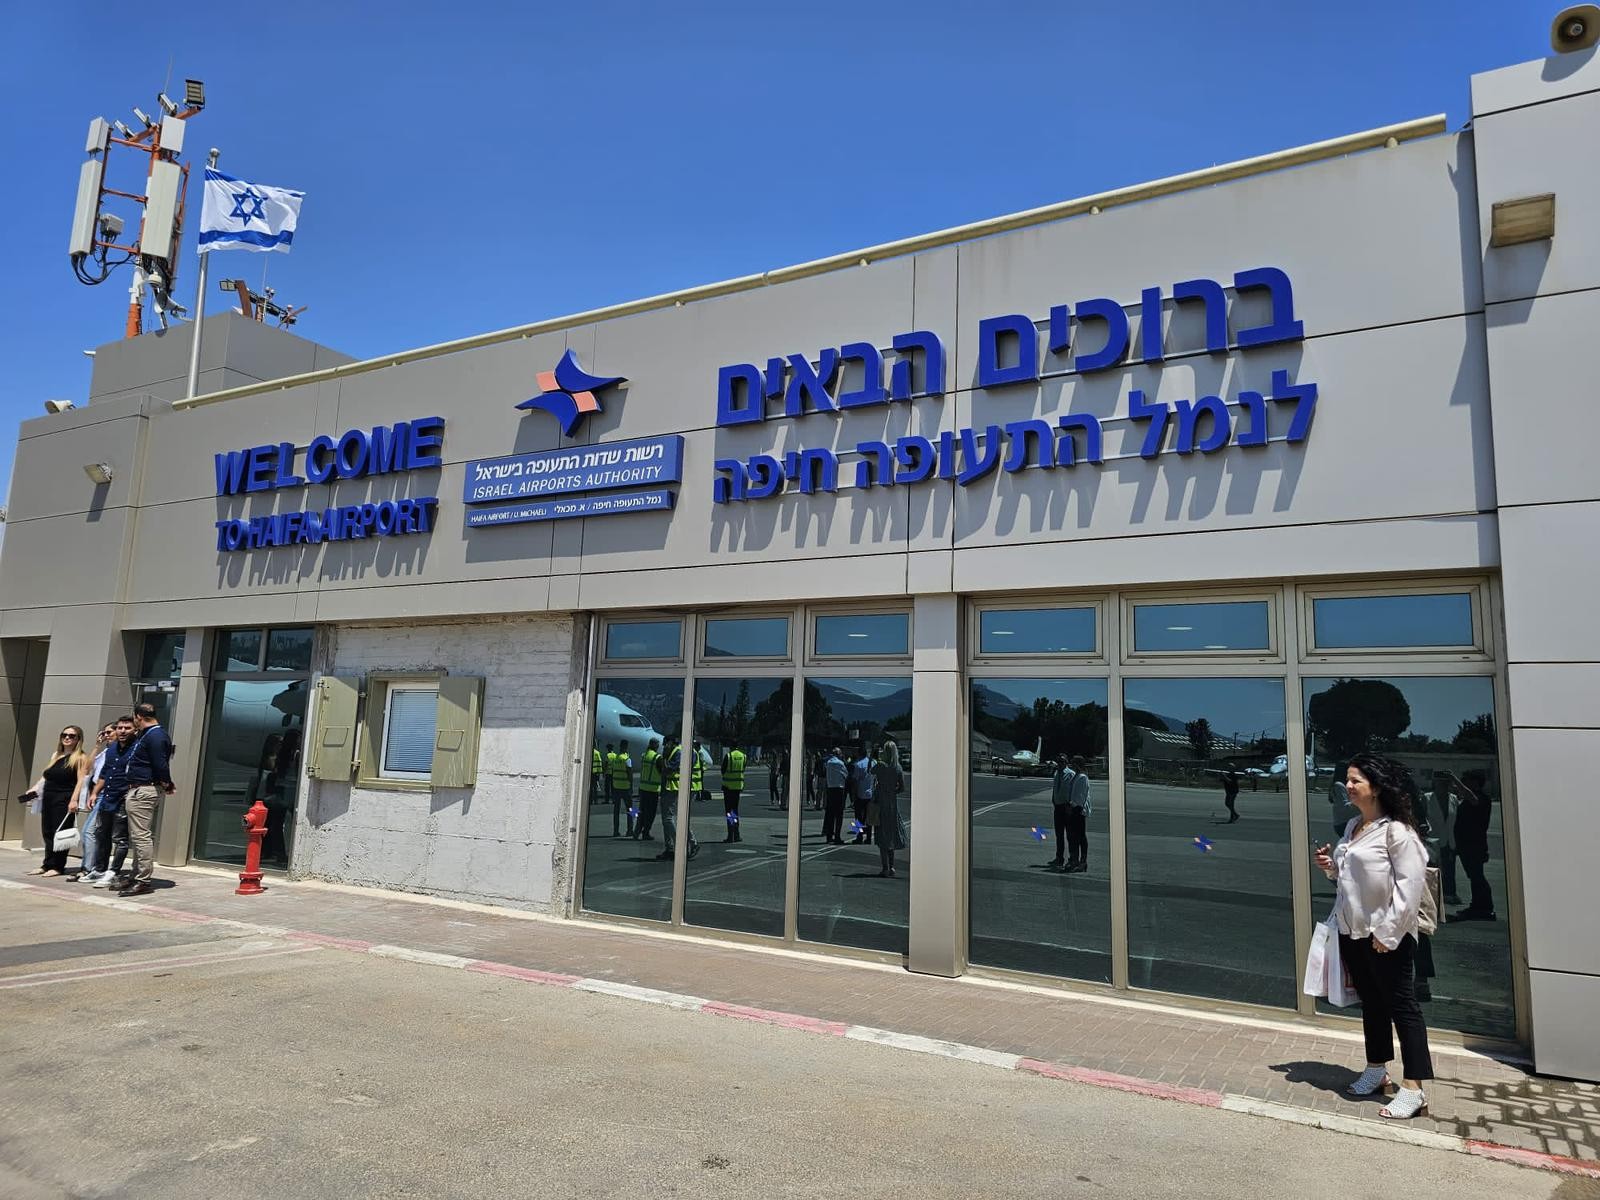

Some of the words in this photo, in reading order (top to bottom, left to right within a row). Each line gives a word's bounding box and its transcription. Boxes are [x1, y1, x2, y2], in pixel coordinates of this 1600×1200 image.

[978, 266, 1304, 389] ברוכים
[716, 330, 946, 428] הבאים
[1128, 369, 1318, 459] לנמל
[214, 416, 445, 497] WELCOME
[526, 455, 580, 475] התעופה
[582, 450, 622, 468] שדות
[624, 444, 664, 462] רשות
[855, 413, 1103, 488] התעופה
[473, 484, 514, 499] ISRAEL
[518, 475, 581, 495] AIRPORTS
[585, 465, 662, 485] AUTHORITY
[475, 463, 523, 481] בישראל
[713, 447, 839, 505] חיפה
[592, 501, 612, 510] חיפה
[613, 498, 645, 508] התעופה
[646, 496, 662, 504] נמל
[215, 519, 250, 551] TO
[249, 511, 319, 548] HAIFA
[319, 497, 439, 544] AIRPORT
